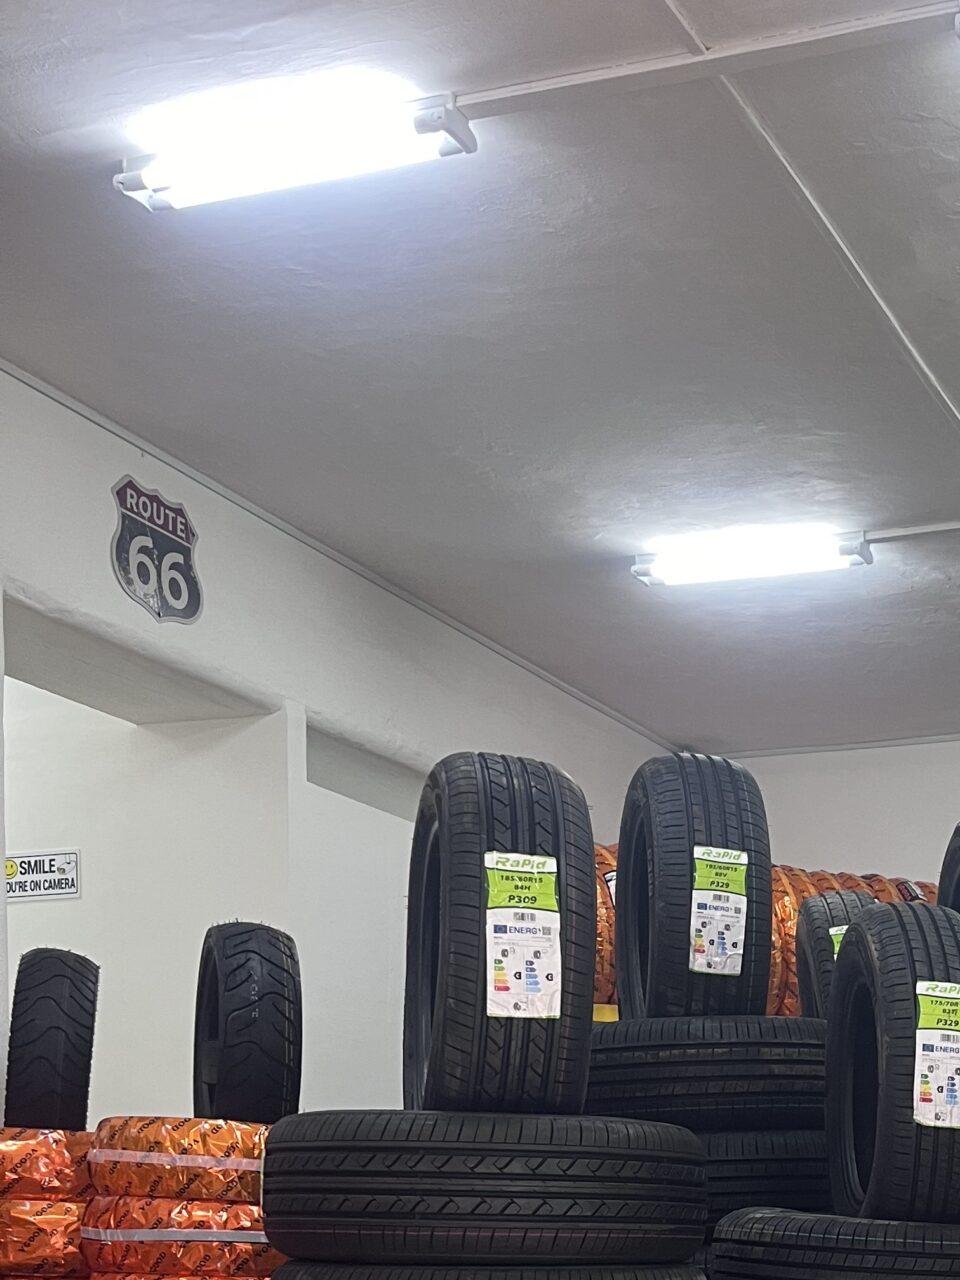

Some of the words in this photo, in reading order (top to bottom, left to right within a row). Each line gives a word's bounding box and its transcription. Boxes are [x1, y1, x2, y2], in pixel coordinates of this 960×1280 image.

[125, 487, 187, 536] ROUTE
[128, 536, 190, 610] 66
[20, 859, 56, 875] SMILE
[6, 881, 28, 893] OU'RE
[30, 880, 41, 891] ON
[43, 878, 75, 890] CAMERA
[508, 895, 537, 904] P309
[936, 1018, 959, 1027] P329
[10, 1149, 38, 1174] VGOOD
